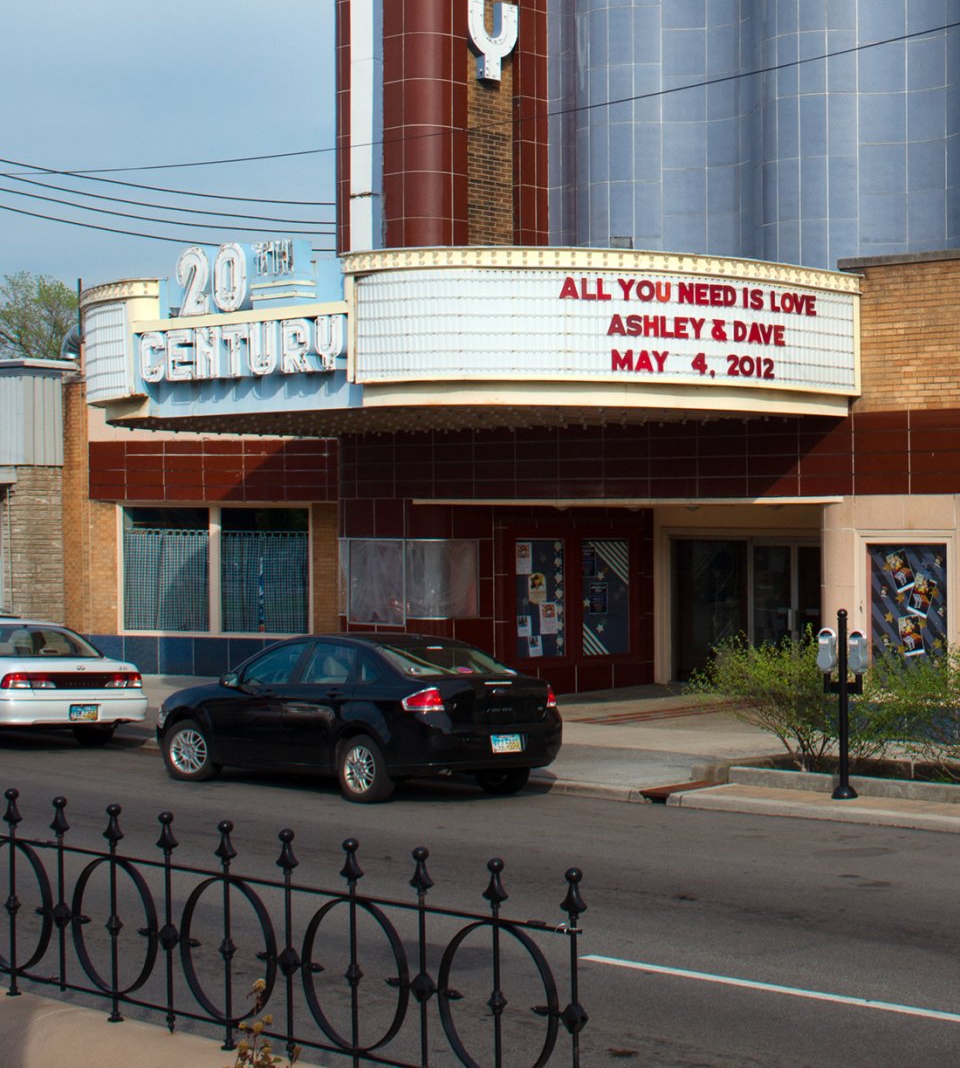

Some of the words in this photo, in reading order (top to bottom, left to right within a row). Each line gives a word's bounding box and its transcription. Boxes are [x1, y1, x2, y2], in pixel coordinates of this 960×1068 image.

[559, 277, 612, 301] ALL
[617, 278, 671, 303] YOU
[677, 281, 737, 308] NEED
[742, 287, 764, 310] IS
[770, 290, 817, 317] LOVE
[138, 314, 346, 383] CENTURY
[607, 314, 706, 340] ASHLEY
[711, 319, 728, 341] &
[733, 320, 786, 347] DAVE
[610, 349, 670, 373] MAY
[691, 352, 716, 378] 4,
[726, 354, 775, 379] 2012
